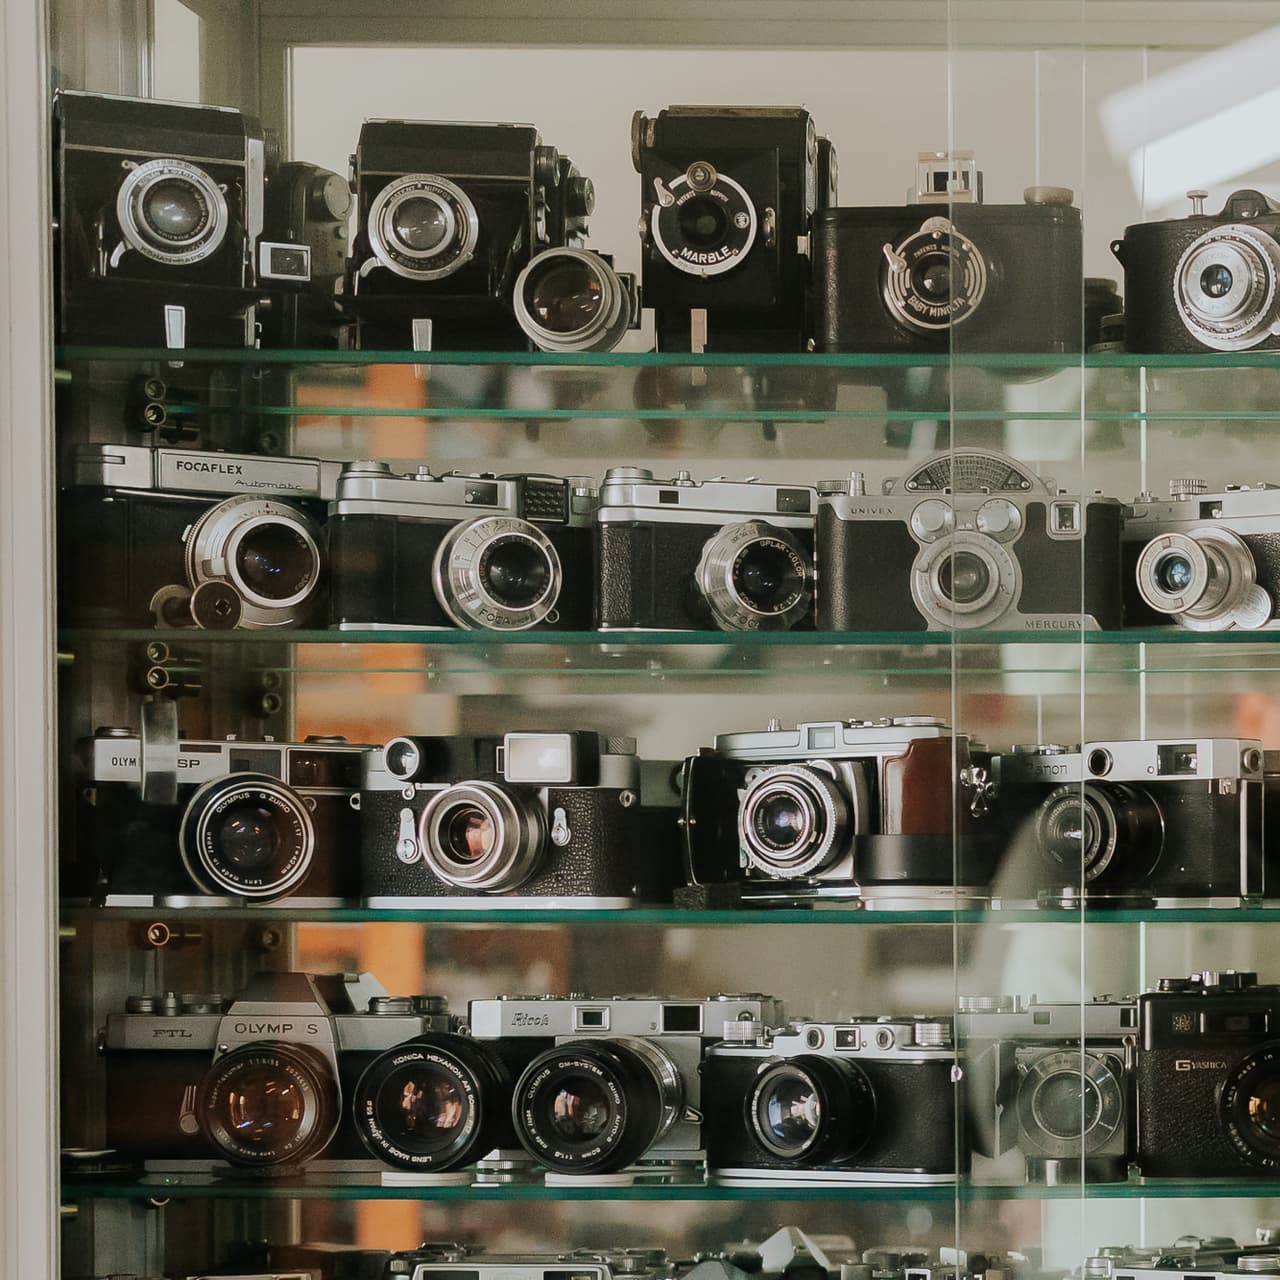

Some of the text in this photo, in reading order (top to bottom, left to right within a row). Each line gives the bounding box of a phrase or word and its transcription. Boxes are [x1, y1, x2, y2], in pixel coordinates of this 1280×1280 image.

[679, 246, 733, 264] MARBLE
[907, 294, 930, 313] BABY
[176, 460, 244, 476] FOCAFLEX
[233, 478, 304, 492] Automatic
[850, 508, 894, 516] UNIVEX
[1024, 619, 1084, 630] MERCURY
[177, 758, 201, 769] SP
[215, 793, 252, 814] OLYMPUS
[152, 1029, 192, 1039] FTL
[391, 1052, 425, 1066] KONICA
[428, 1052, 464, 1077] HEXANON
